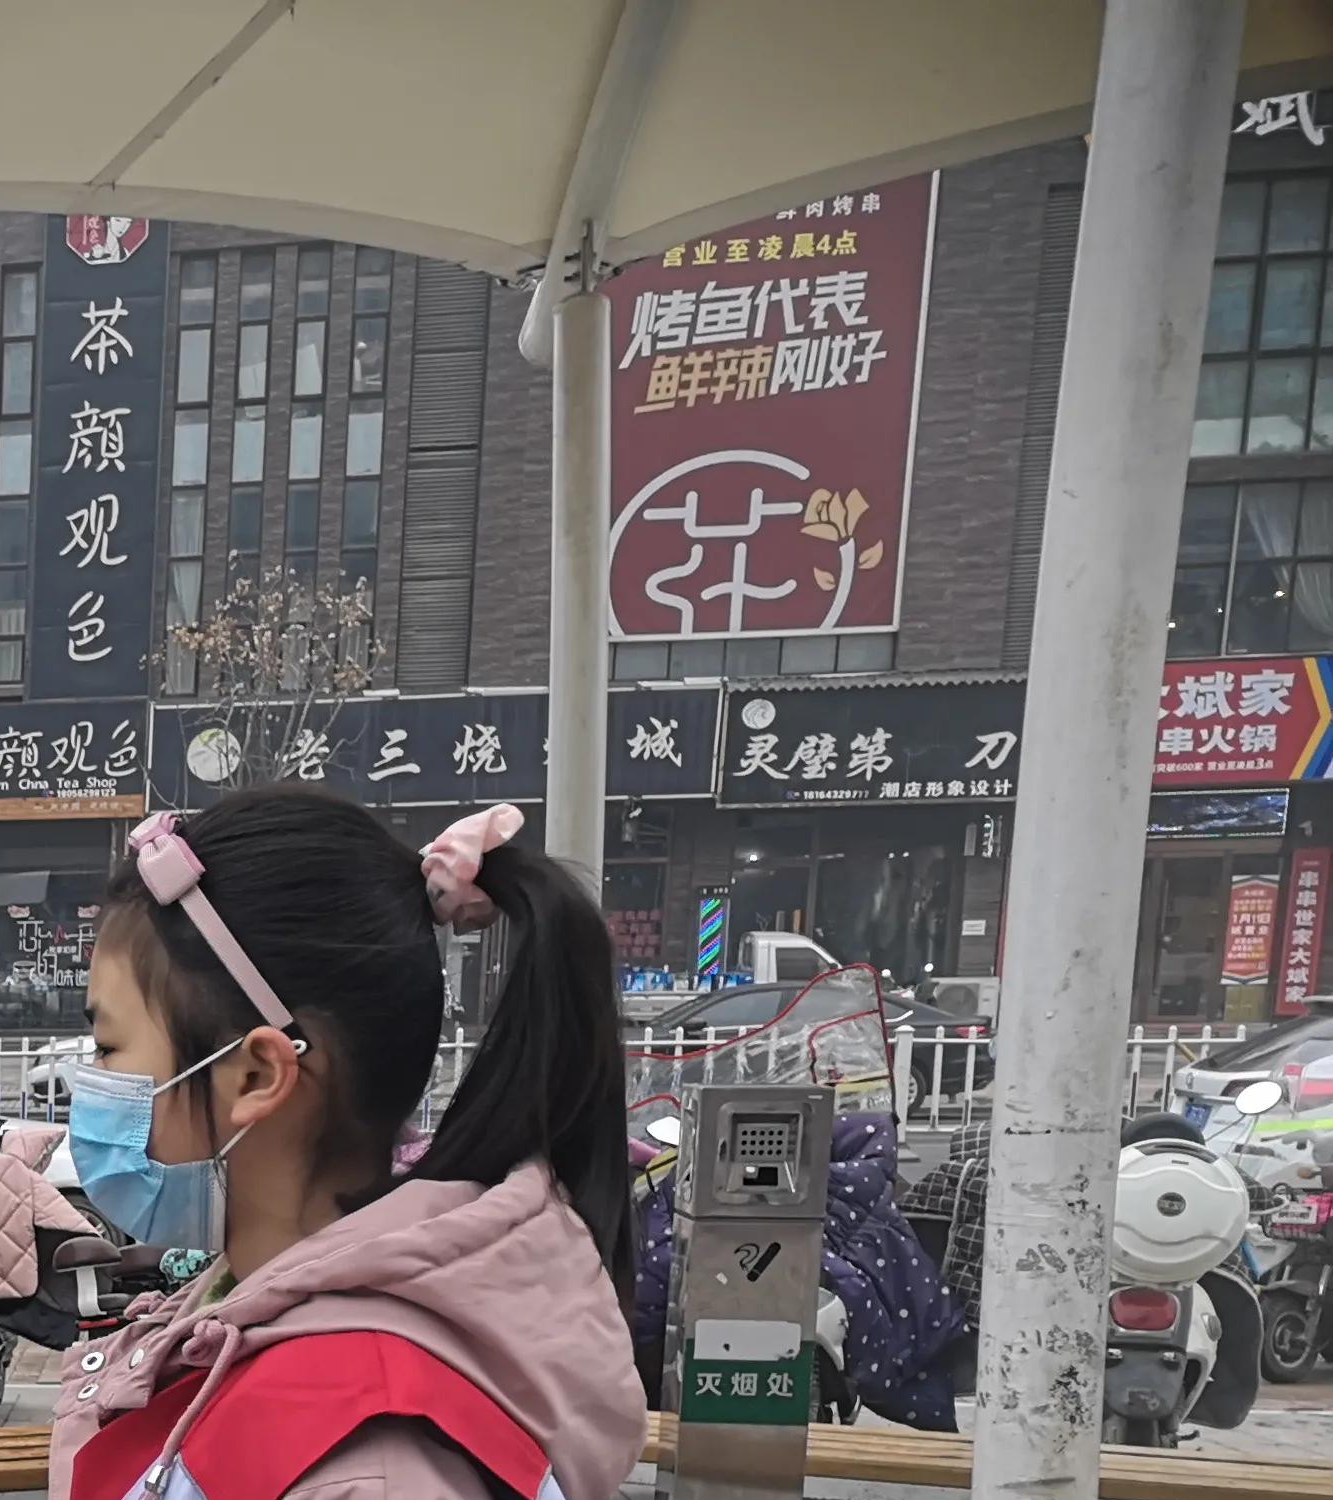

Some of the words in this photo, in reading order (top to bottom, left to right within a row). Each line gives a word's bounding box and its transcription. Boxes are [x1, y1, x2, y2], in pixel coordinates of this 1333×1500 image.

[662, 230, 857, 268] 营业至凌晨4点
[619, 271, 869, 370] 烤鱼代表
[634, 330, 887, 414] 鲜辣刚好
[1158, 669, 1294, 720] 斌家
[285, 716, 682, 782] 老三烧城
[1158, 724, 1277, 756] 串火锅
[57, 778, 79, 788] Tea
[86, 776, 117, 788] Shop
[1154, 760, 1204, 773] 突破600家
[879, 778, 1013, 799] 潮店形象设计
[694, 1369, 795, 1400] 灭烟处
